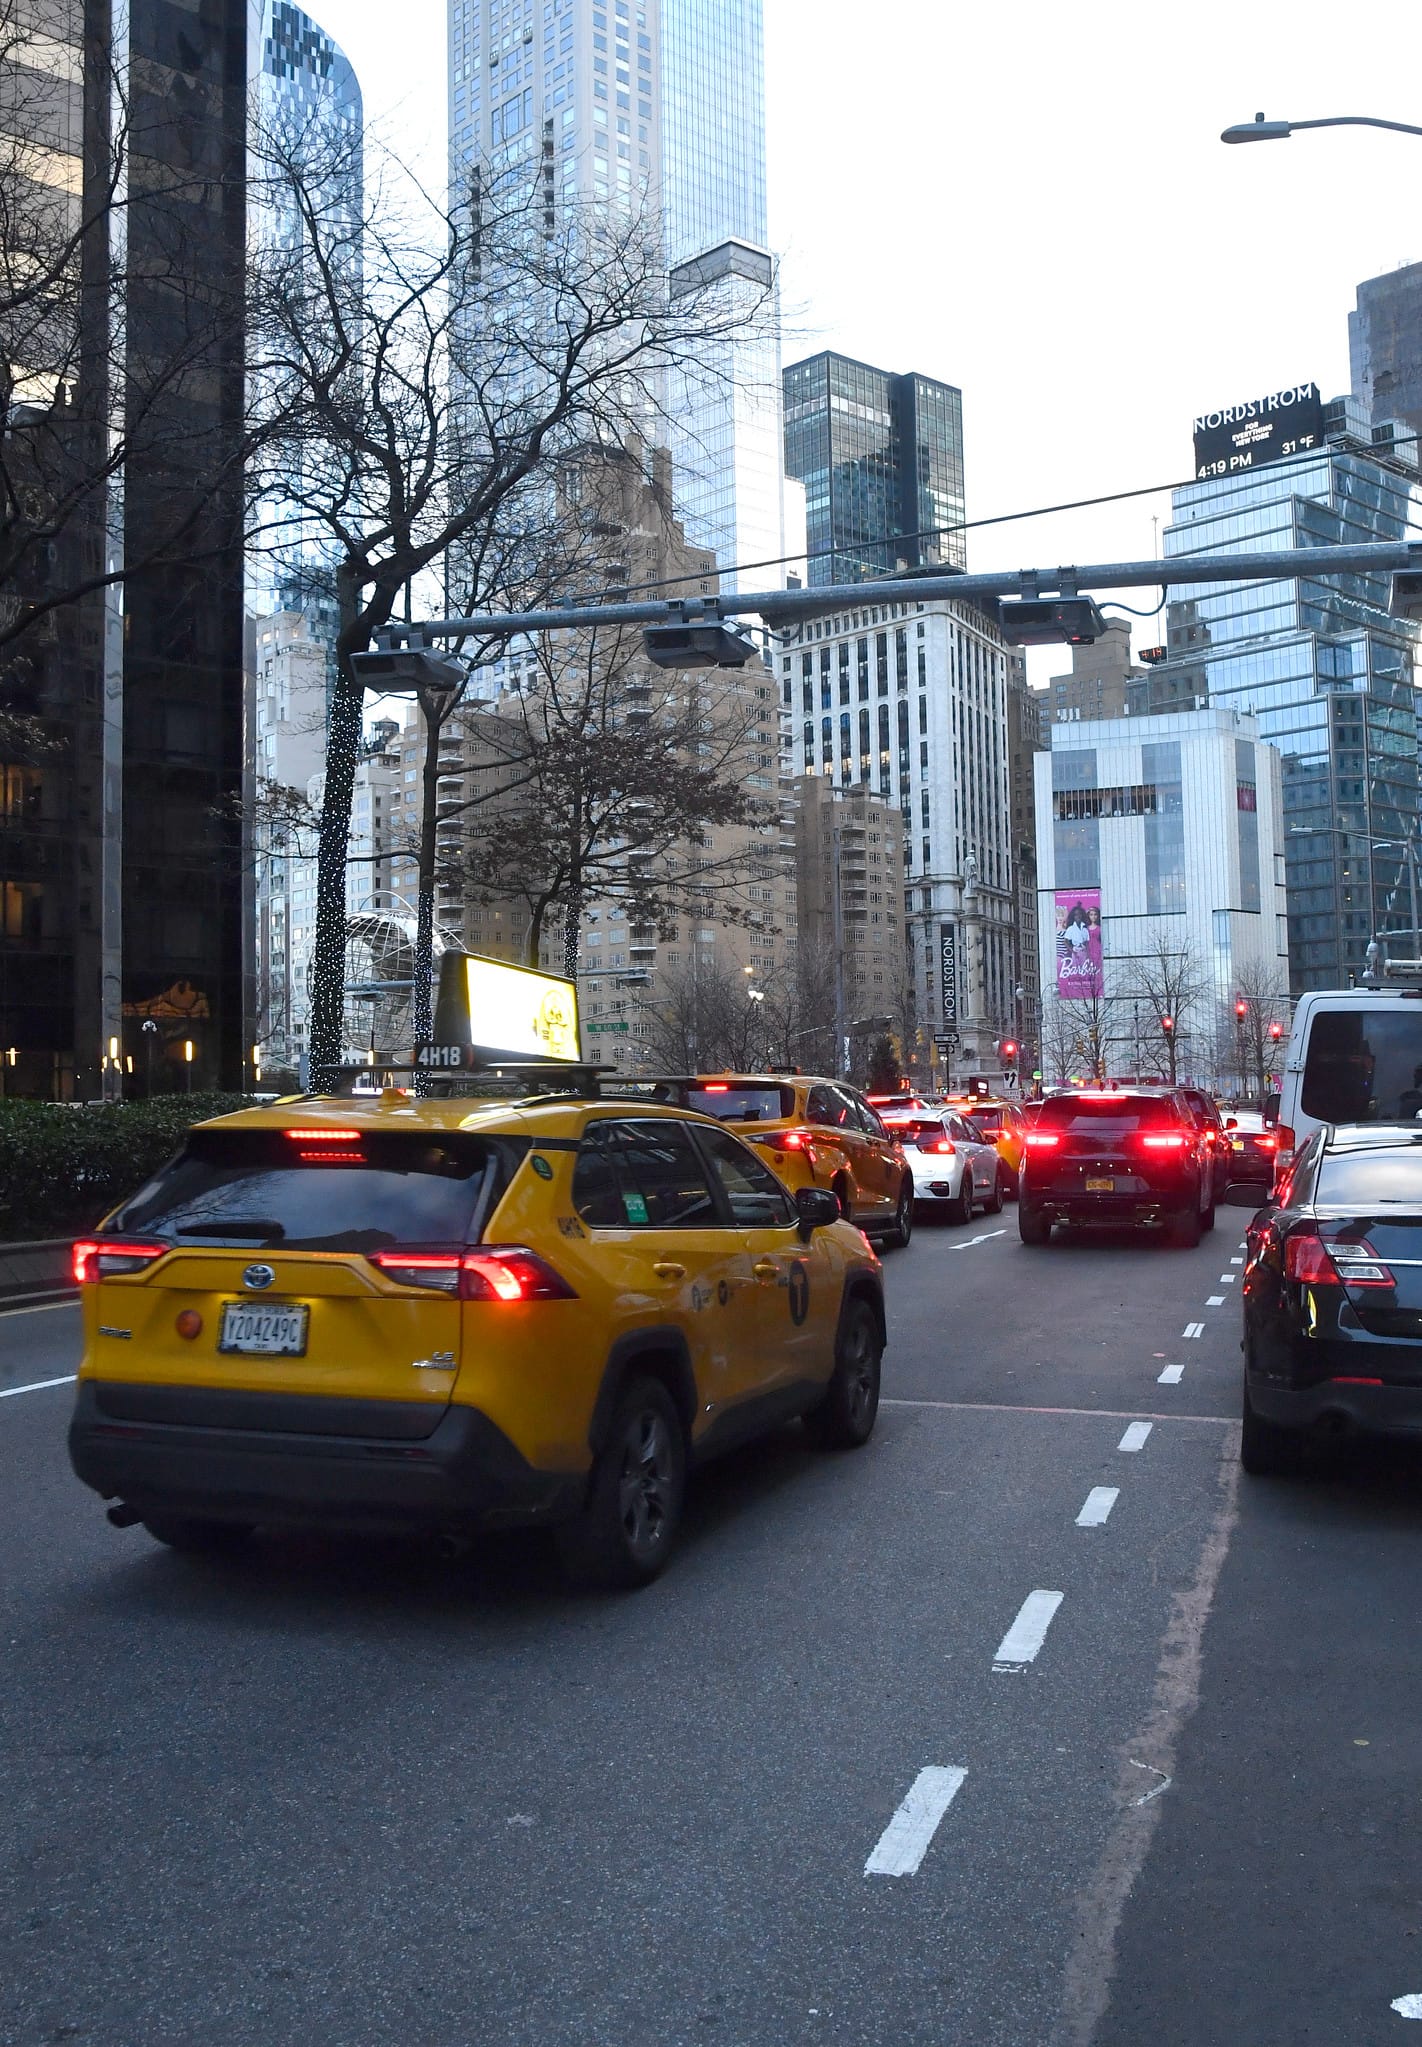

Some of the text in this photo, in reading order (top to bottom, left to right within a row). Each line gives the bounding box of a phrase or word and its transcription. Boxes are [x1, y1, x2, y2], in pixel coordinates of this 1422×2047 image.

[1193, 383, 1312, 434] NORDSTROM
[1282, 440, 1297, 454] 31
[1198, 452, 1252, 478] 4:19 PM
[942, 937, 955, 1019] NORDSTROM
[418, 1046, 461, 1066] 4H18
[228, 1314, 298, 1343] Y204249C
